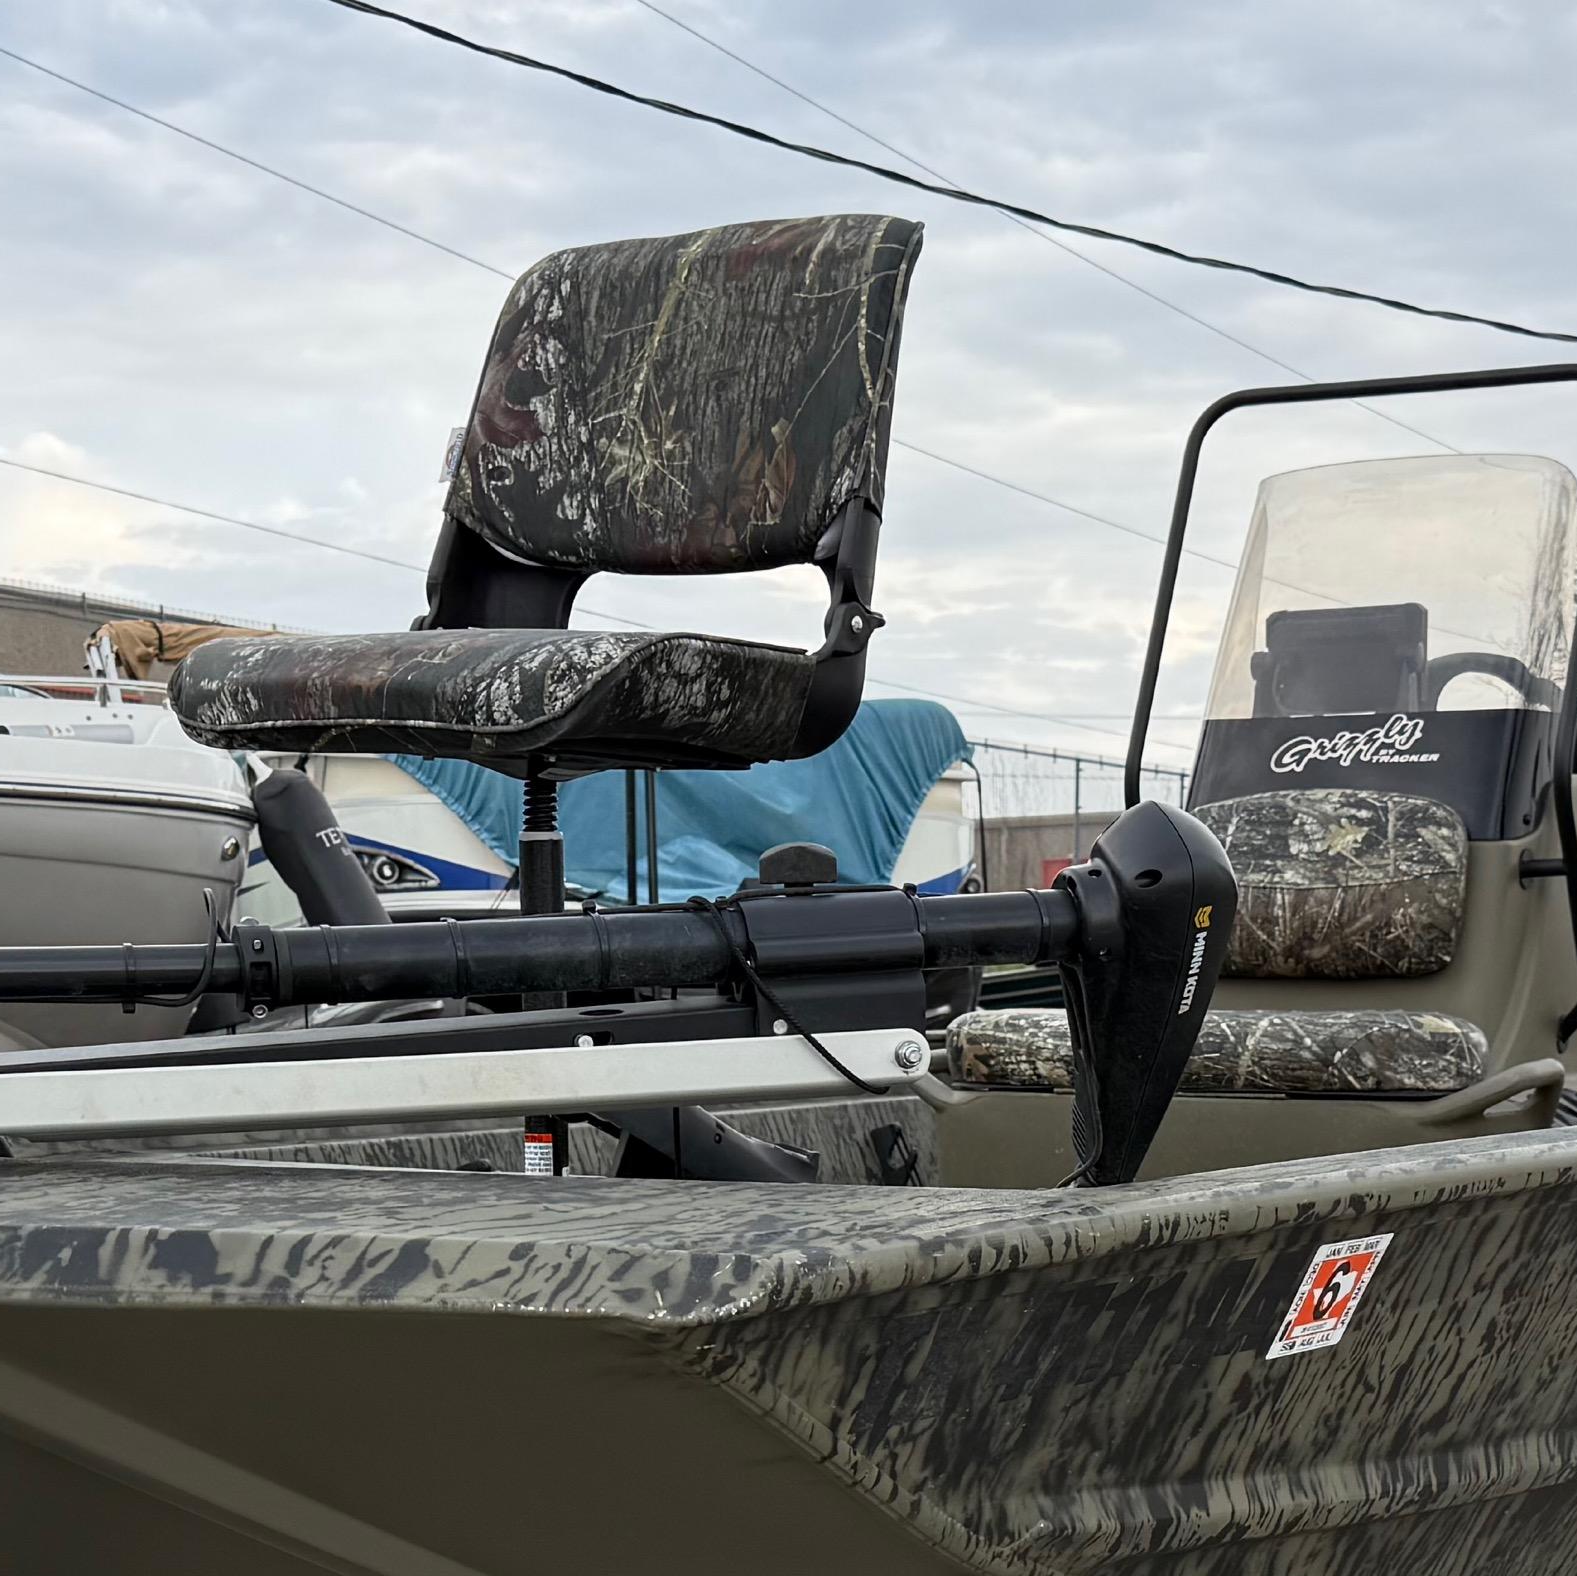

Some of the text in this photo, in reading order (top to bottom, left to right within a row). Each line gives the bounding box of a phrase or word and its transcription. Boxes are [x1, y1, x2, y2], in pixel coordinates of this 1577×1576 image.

[1270, 714, 1424, 773] Grizzly
[1371, 754, 1440, 764] TRACKER
[1177, 931, 1207, 1015] MINN KOTA
[1313, 1260, 1351, 1320] 6
